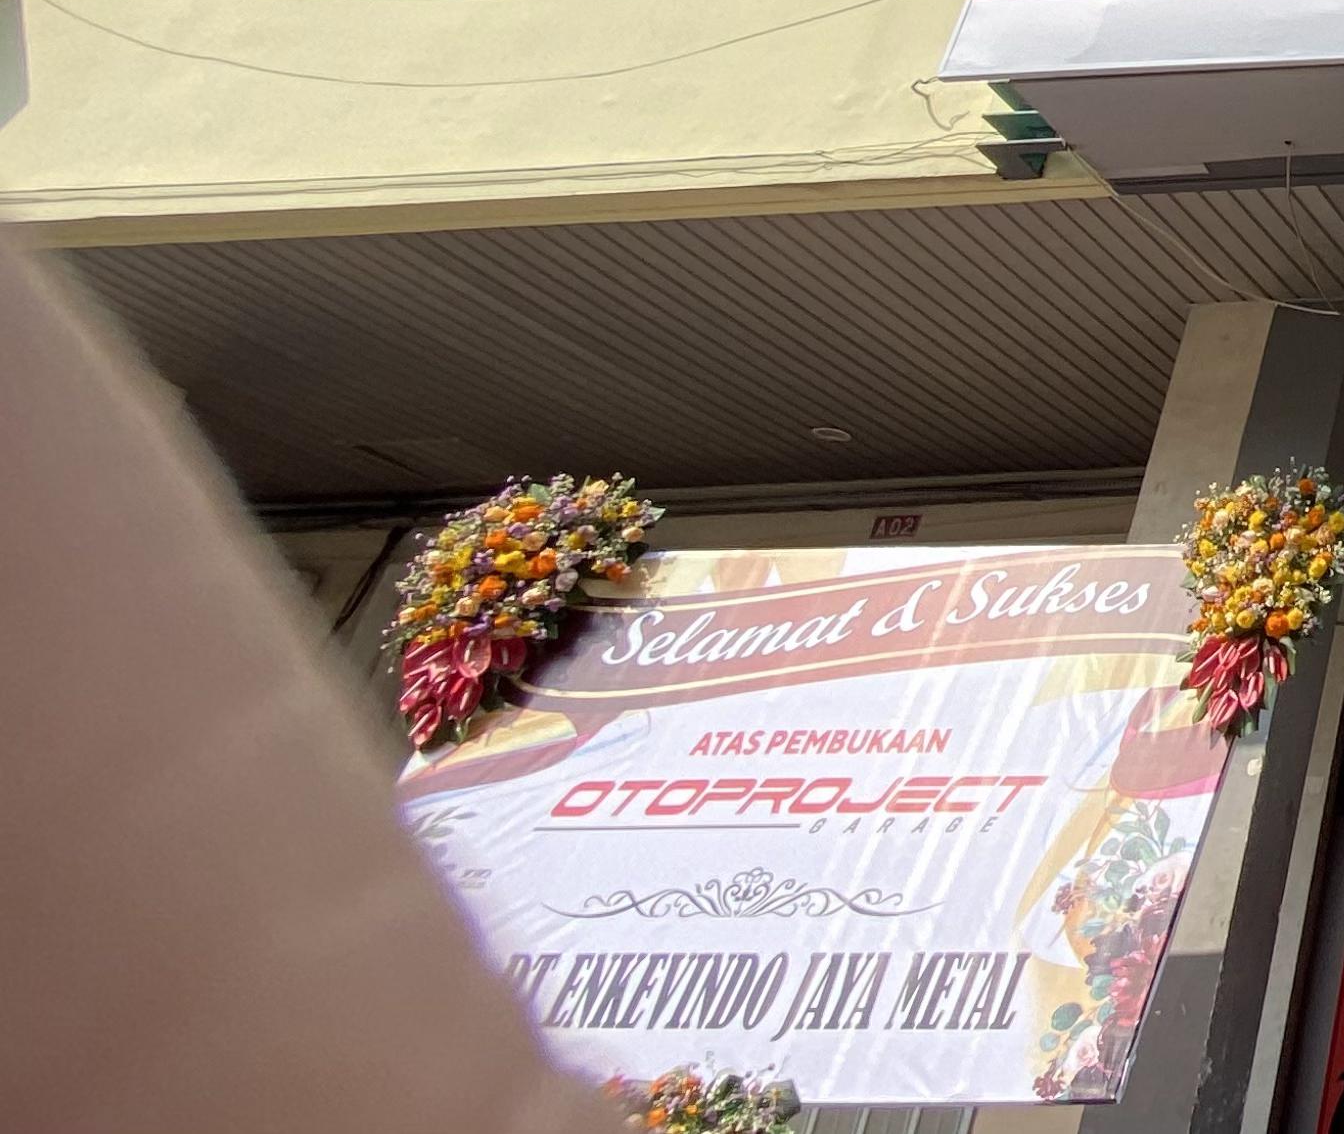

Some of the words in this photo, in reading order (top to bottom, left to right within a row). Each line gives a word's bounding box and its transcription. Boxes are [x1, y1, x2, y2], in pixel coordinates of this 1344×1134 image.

[874, 516, 917, 537] A02
[601, 597, 868, 667] Selamat
[948, 562, 1152, 626] Sukses
[689, 730, 764, 756] ATAS
[764, 728, 953, 755] PEMBUKAAN
[550, 775, 1049, 817] OTOPROJECT
[808, 816, 999, 835] GARAGE
[543, 952, 791, 1031] ENKEVINDO
[769, 952, 893, 1043] JAYA
[884, 952, 1033, 1031] METAL
